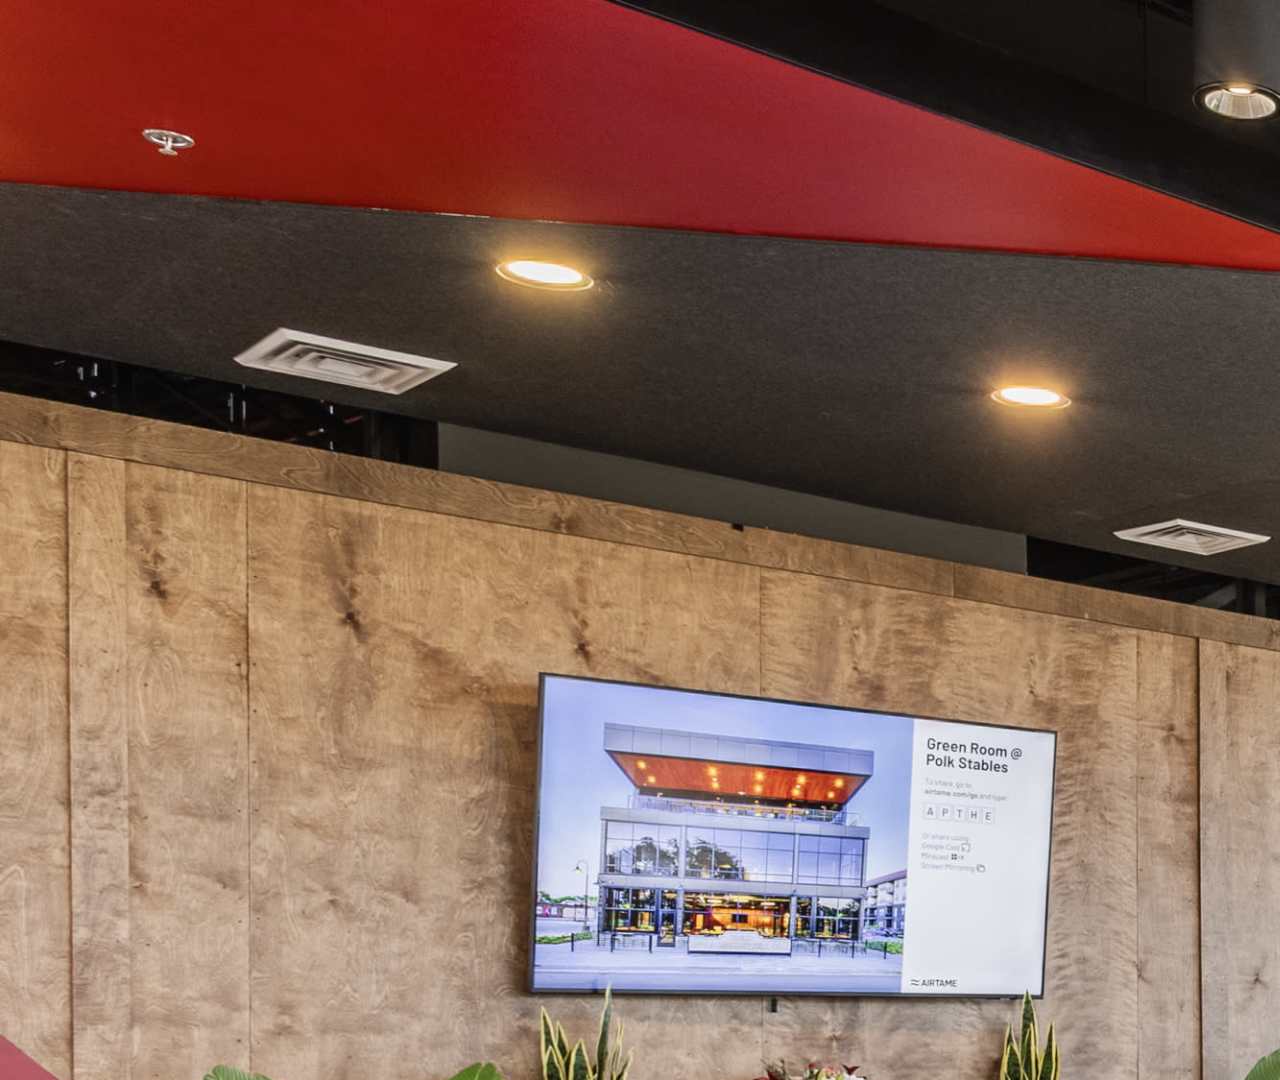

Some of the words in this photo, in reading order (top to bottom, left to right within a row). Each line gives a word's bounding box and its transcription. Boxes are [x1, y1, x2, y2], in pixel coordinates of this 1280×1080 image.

[927, 738, 967, 753] Green
[970, 742, 1008, 758] Room
[1010, 748, 1023, 760] @
[926, 754, 955, 768] Polk
[958, 757, 1008, 773] Stables
[920, 979, 958, 987] AIRTAME
